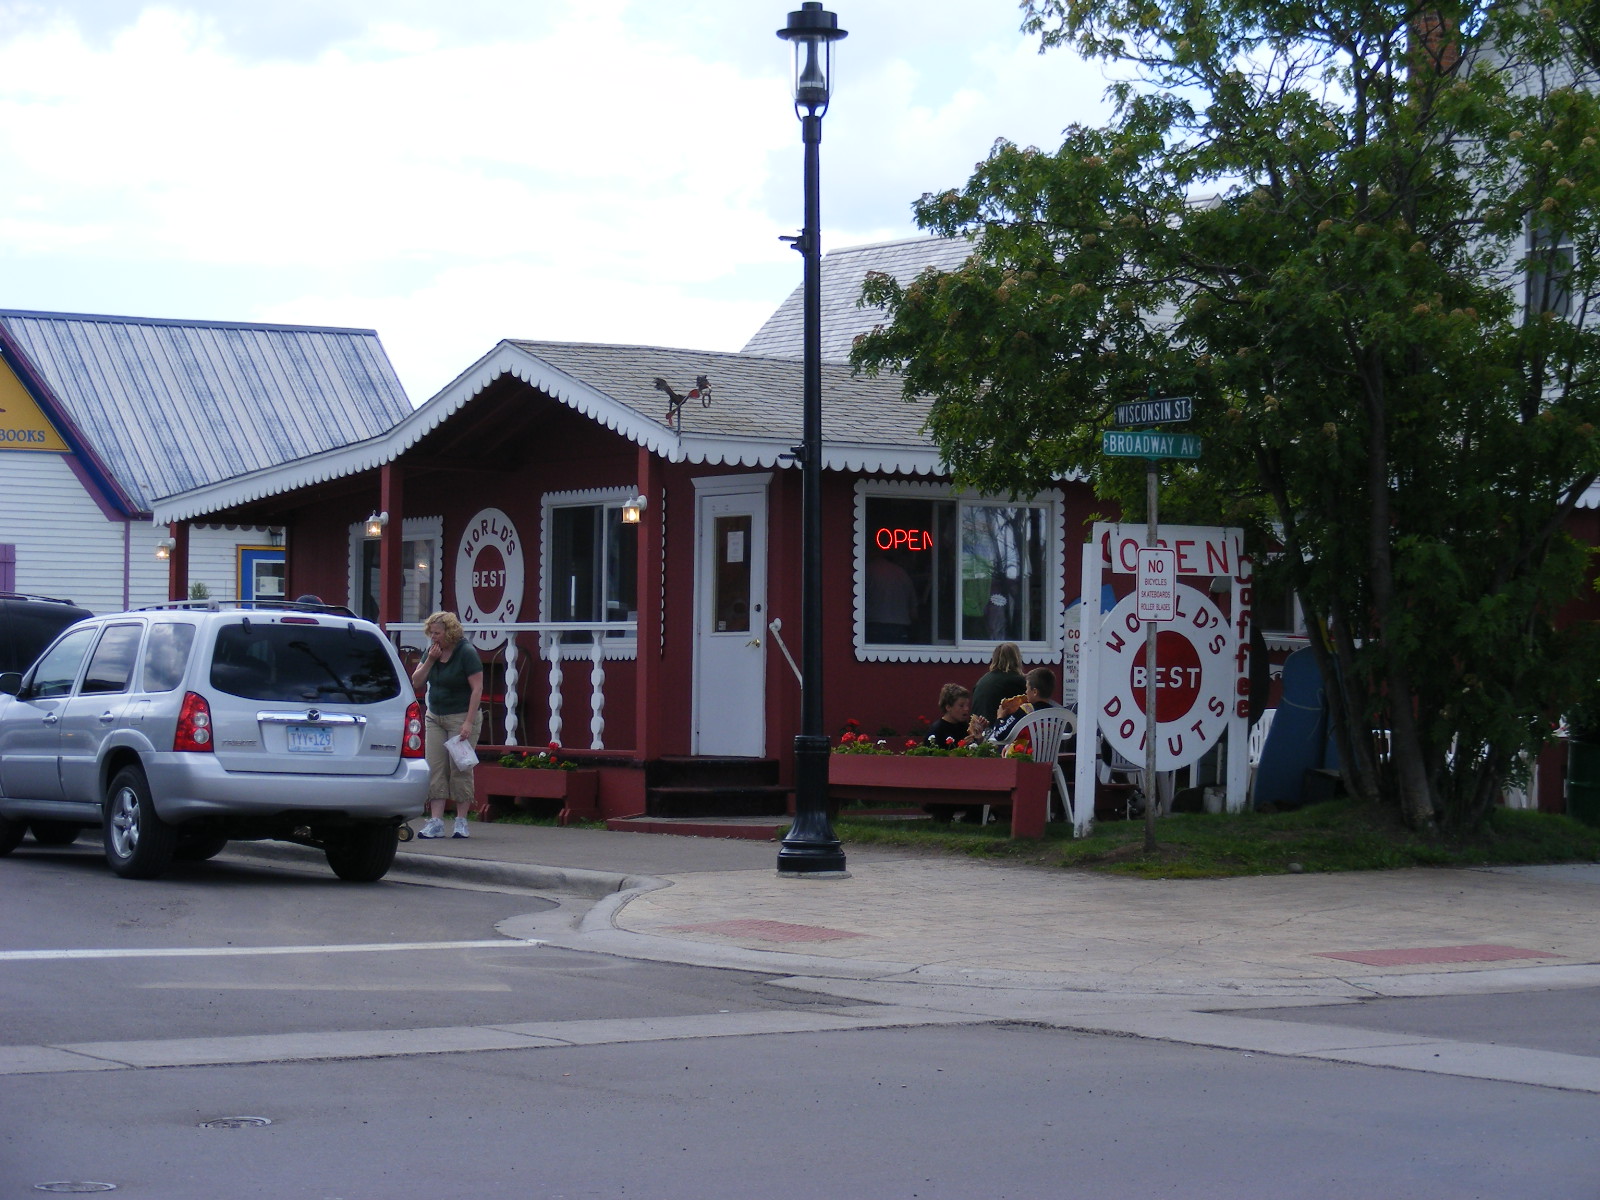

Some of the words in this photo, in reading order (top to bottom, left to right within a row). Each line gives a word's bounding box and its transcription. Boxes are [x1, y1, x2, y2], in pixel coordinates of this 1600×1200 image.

[1117, 402, 1171, 424] WISCONSIN
[1109, 434, 1174, 453] BROADWAY
[464, 518, 516, 558] WORLD'S
[1120, 538, 1229, 573] OEN
[1148, 559, 1164, 573] NO
[472, 569, 505, 588] BEST
[1144, 578, 1167, 586] BICYCLES
[1141, 590, 1170, 598] SKATEBOARDS
[1140, 603, 1155, 611] ROLLER
[1156, 603, 1170, 611] BLADES
[1106, 593, 1226, 655] WOLD'S
